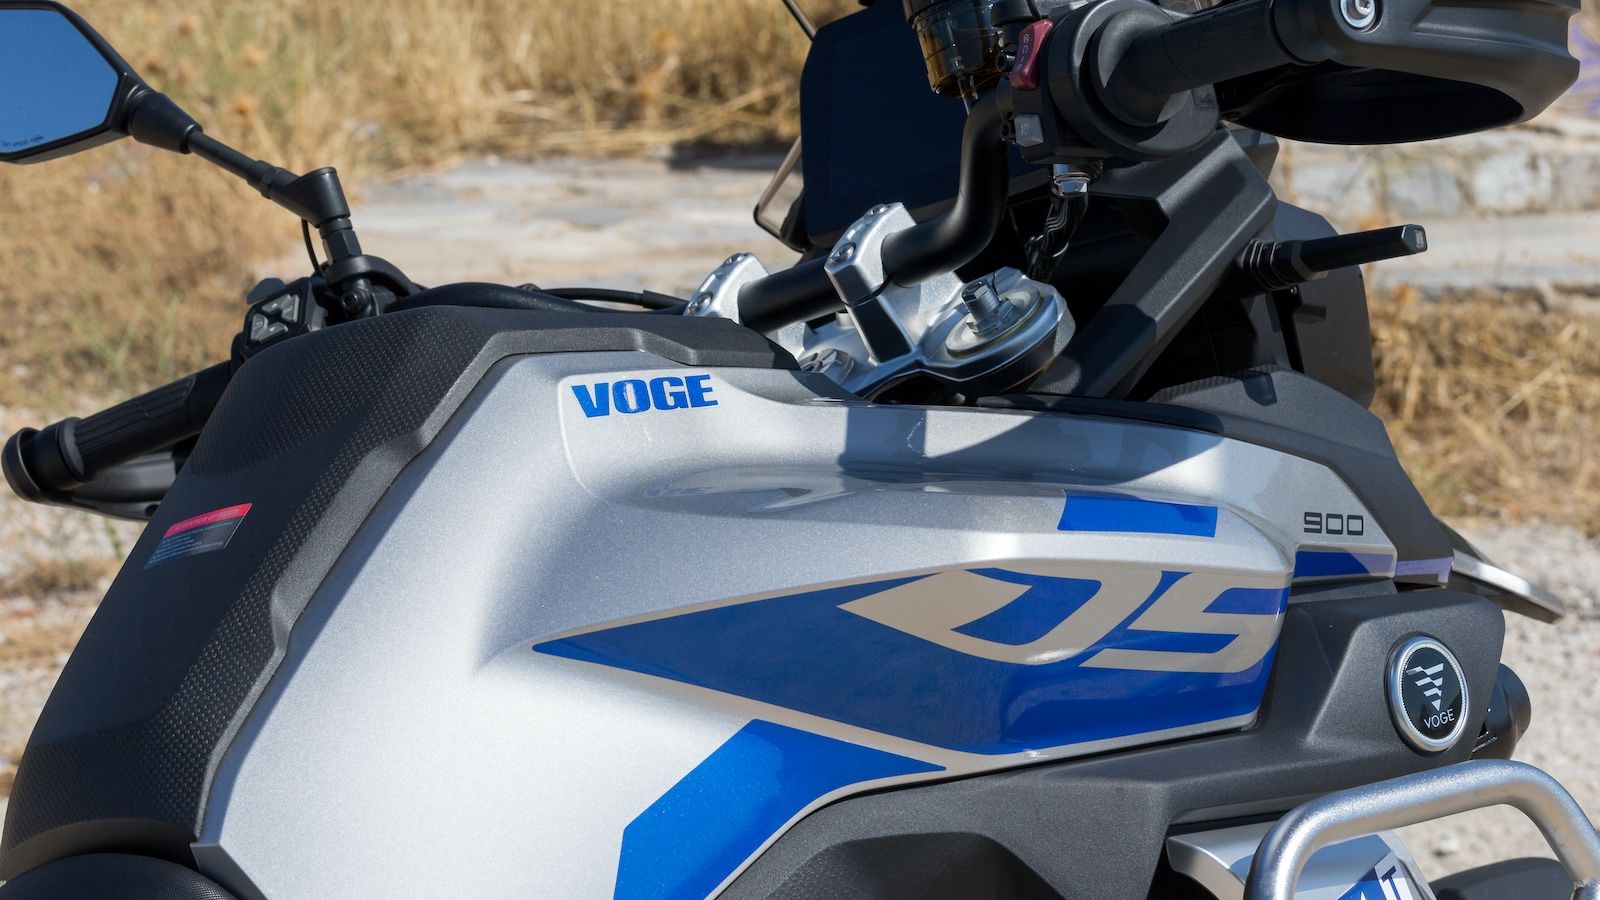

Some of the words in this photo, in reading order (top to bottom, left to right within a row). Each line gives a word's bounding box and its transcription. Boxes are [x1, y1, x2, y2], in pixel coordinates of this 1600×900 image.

[571, 374, 719, 418] VOGE
[1303, 511, 1364, 536] 900
[836, 567, 1288, 674] DS
[1423, 708, 1455, 729] VOGE
